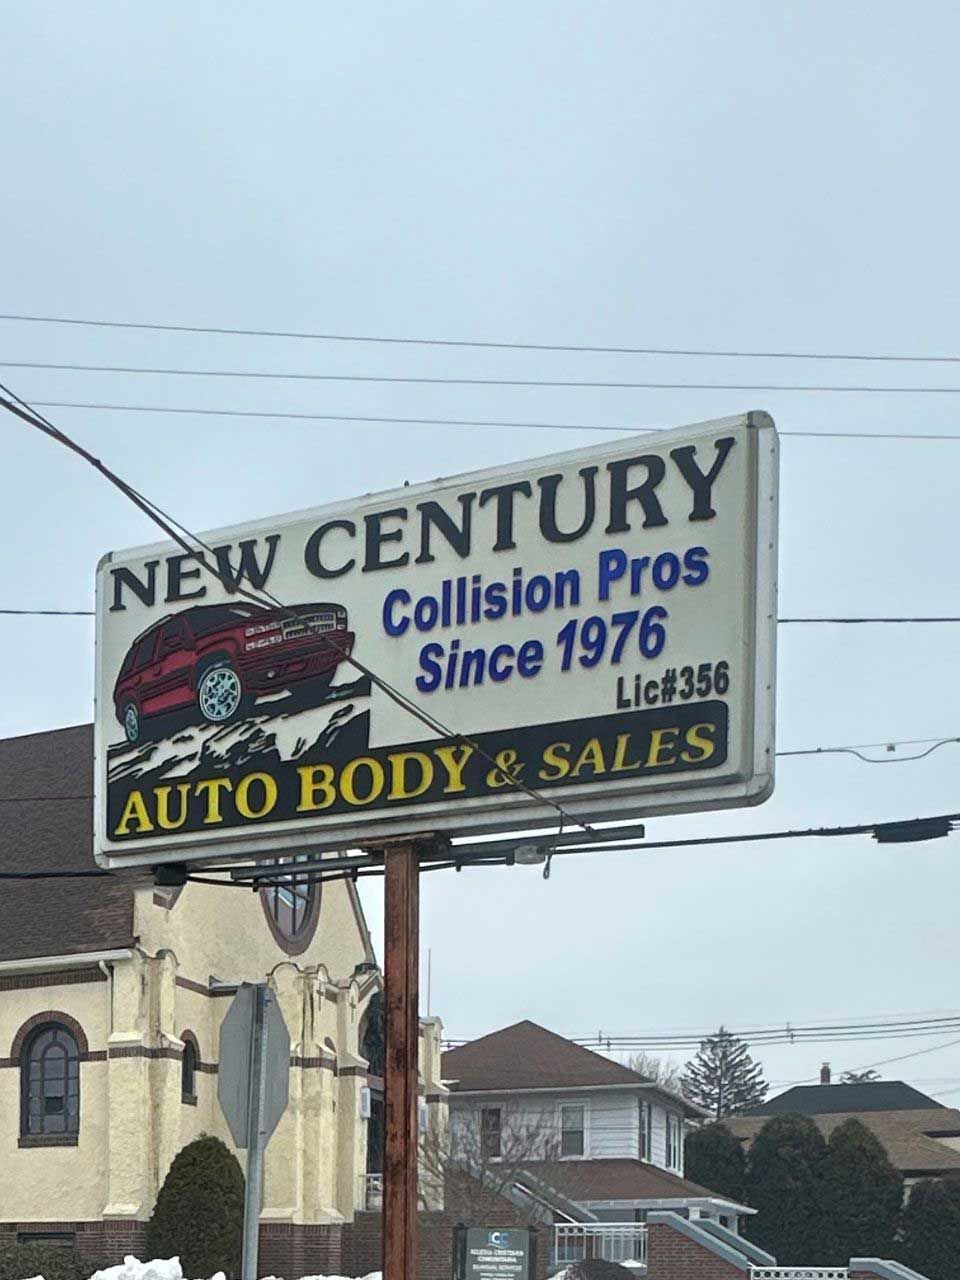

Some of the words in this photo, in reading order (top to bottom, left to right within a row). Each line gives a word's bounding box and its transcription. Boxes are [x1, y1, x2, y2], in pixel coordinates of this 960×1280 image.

[109, 534, 281, 612] NEW
[304, 437, 736, 579] CENTURY
[383, 568, 581, 637] Collision
[598, 546, 710, 601] Pros
[416, 638, 545, 693] Since
[555, 606, 668, 672] 1976
[616, 661, 731, 710] Lic#356
[114, 773, 279, 836] AUTO
[298, 744, 480, 812] BODY
[486, 750, 526, 788] &
[539, 723, 717, 778] SALES
